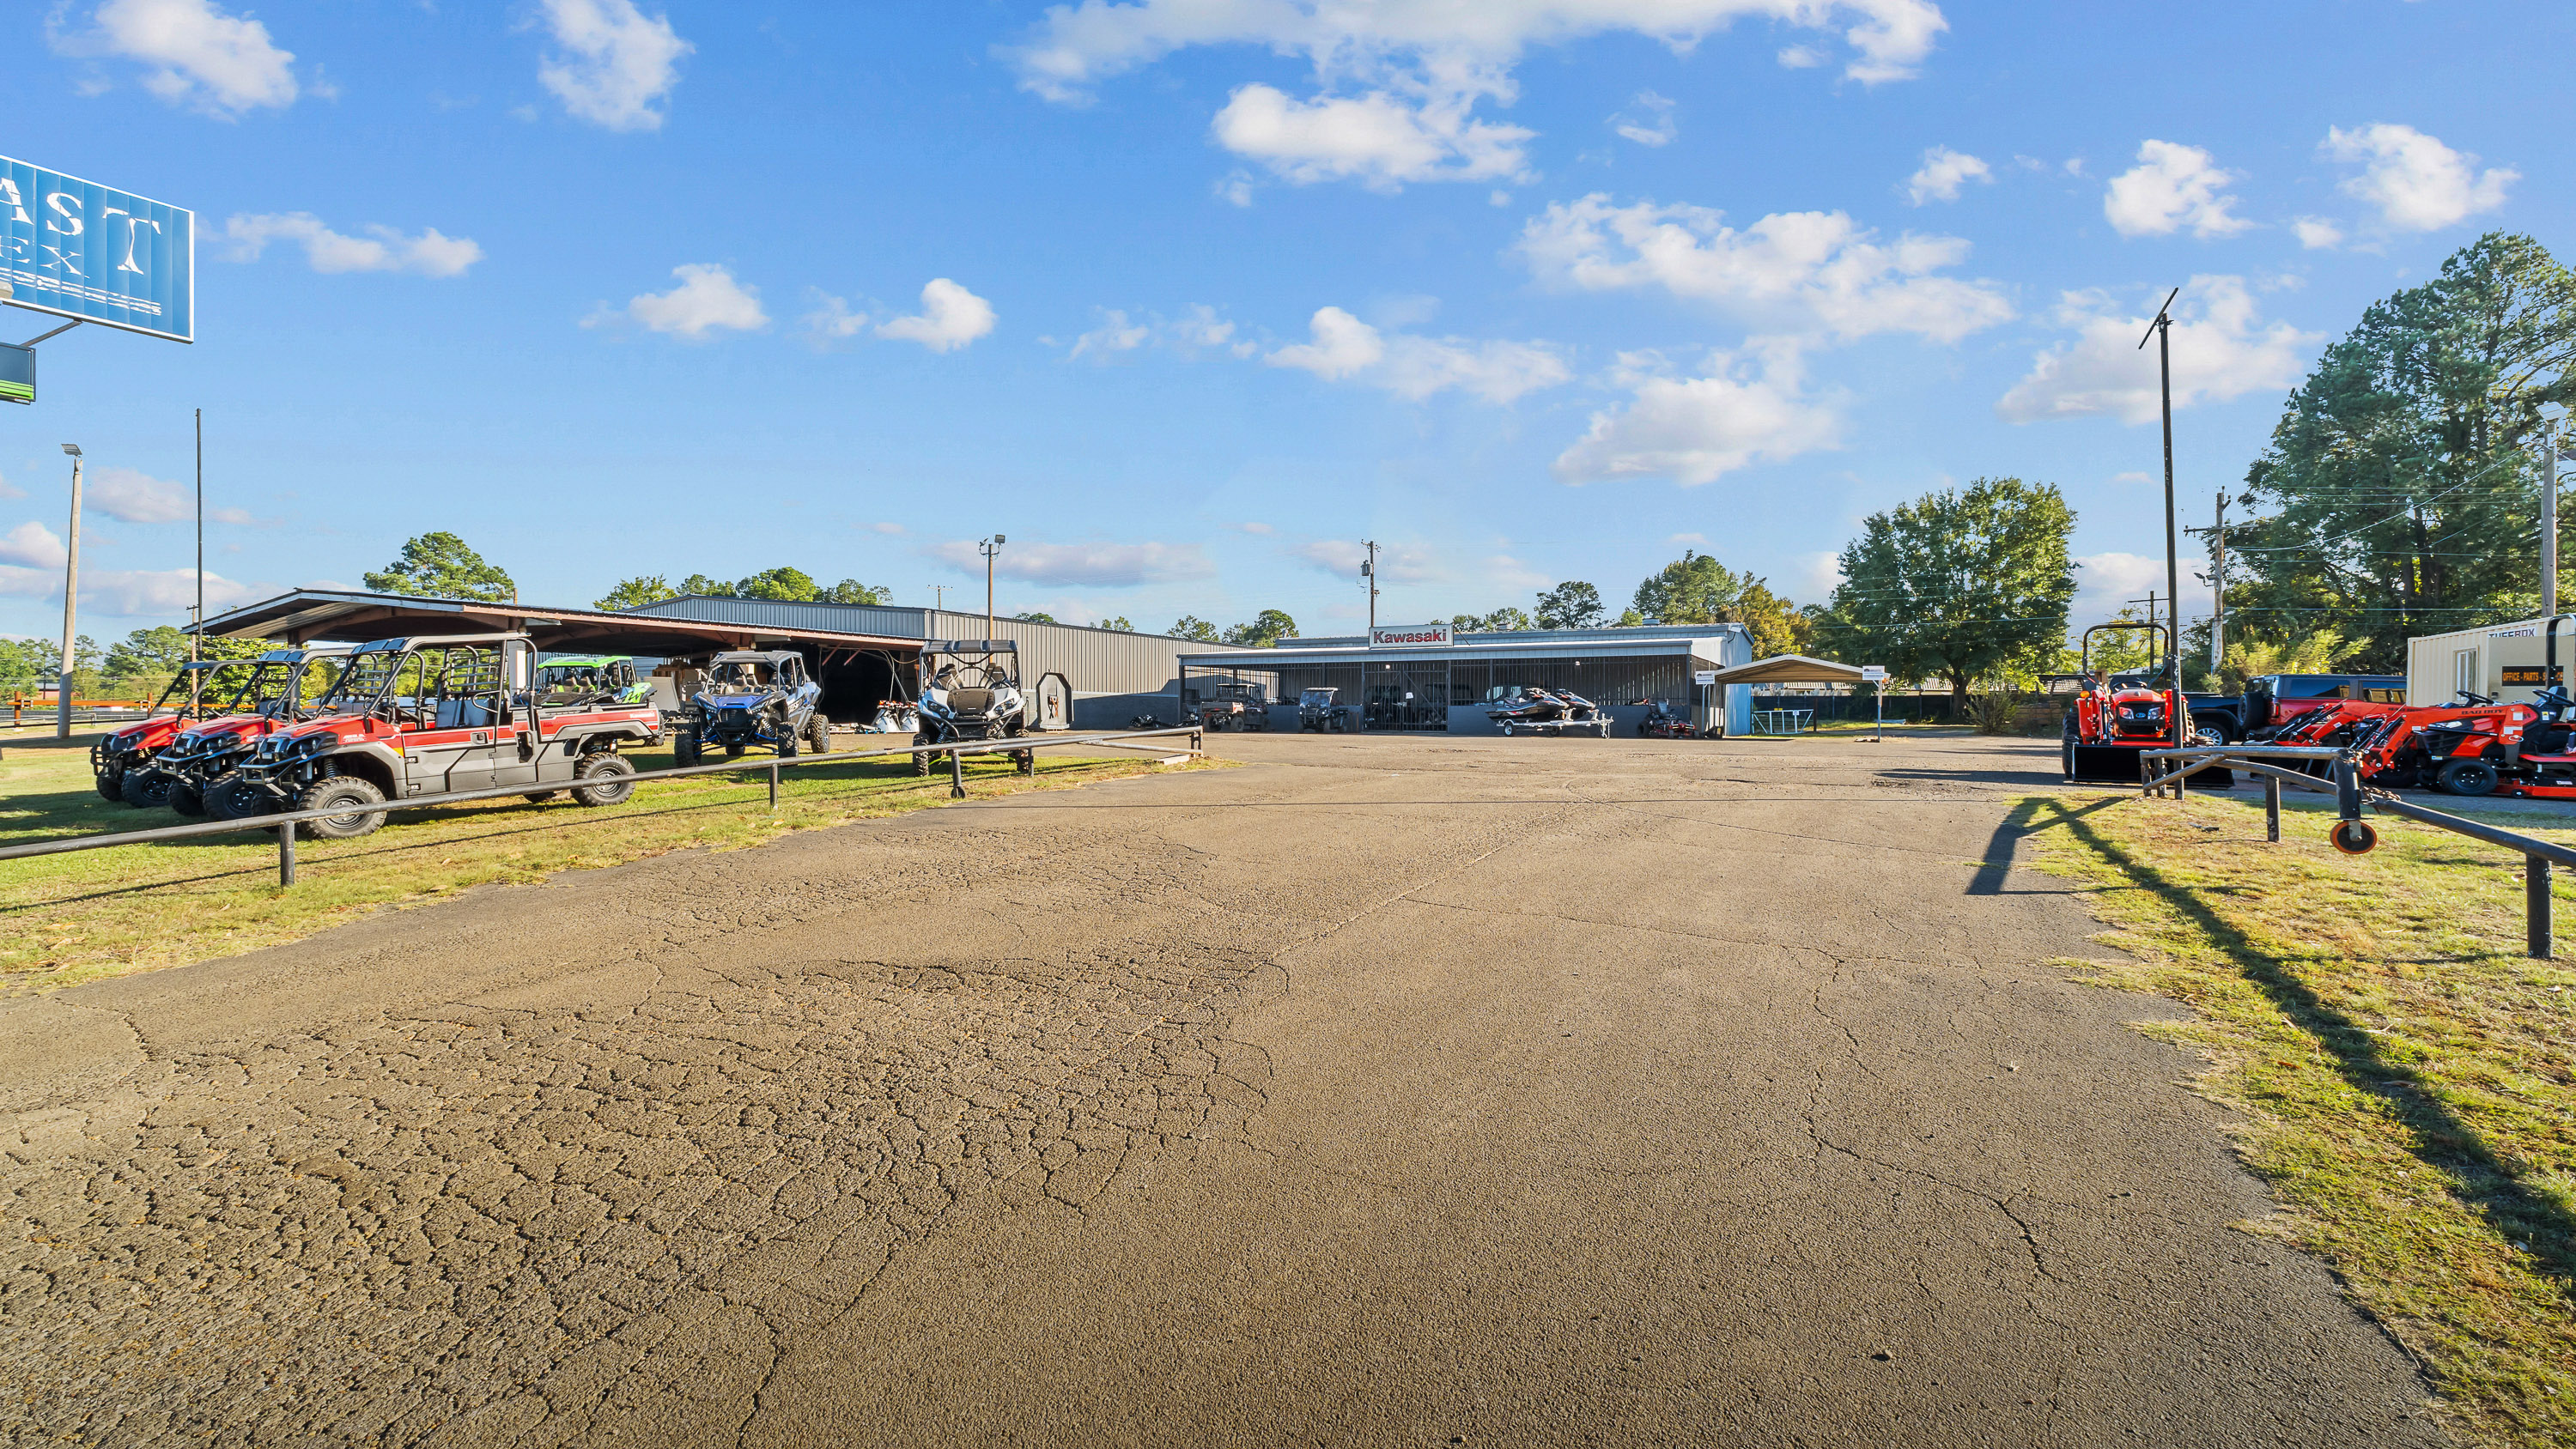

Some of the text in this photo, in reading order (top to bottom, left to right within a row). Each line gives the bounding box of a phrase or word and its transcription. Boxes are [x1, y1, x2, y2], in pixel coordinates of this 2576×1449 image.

[1373, 628, 1447, 644] Kawasaki
[2502, 672, 2520, 682] OFFICE
[2523, 672, 2539, 682] PARTS
